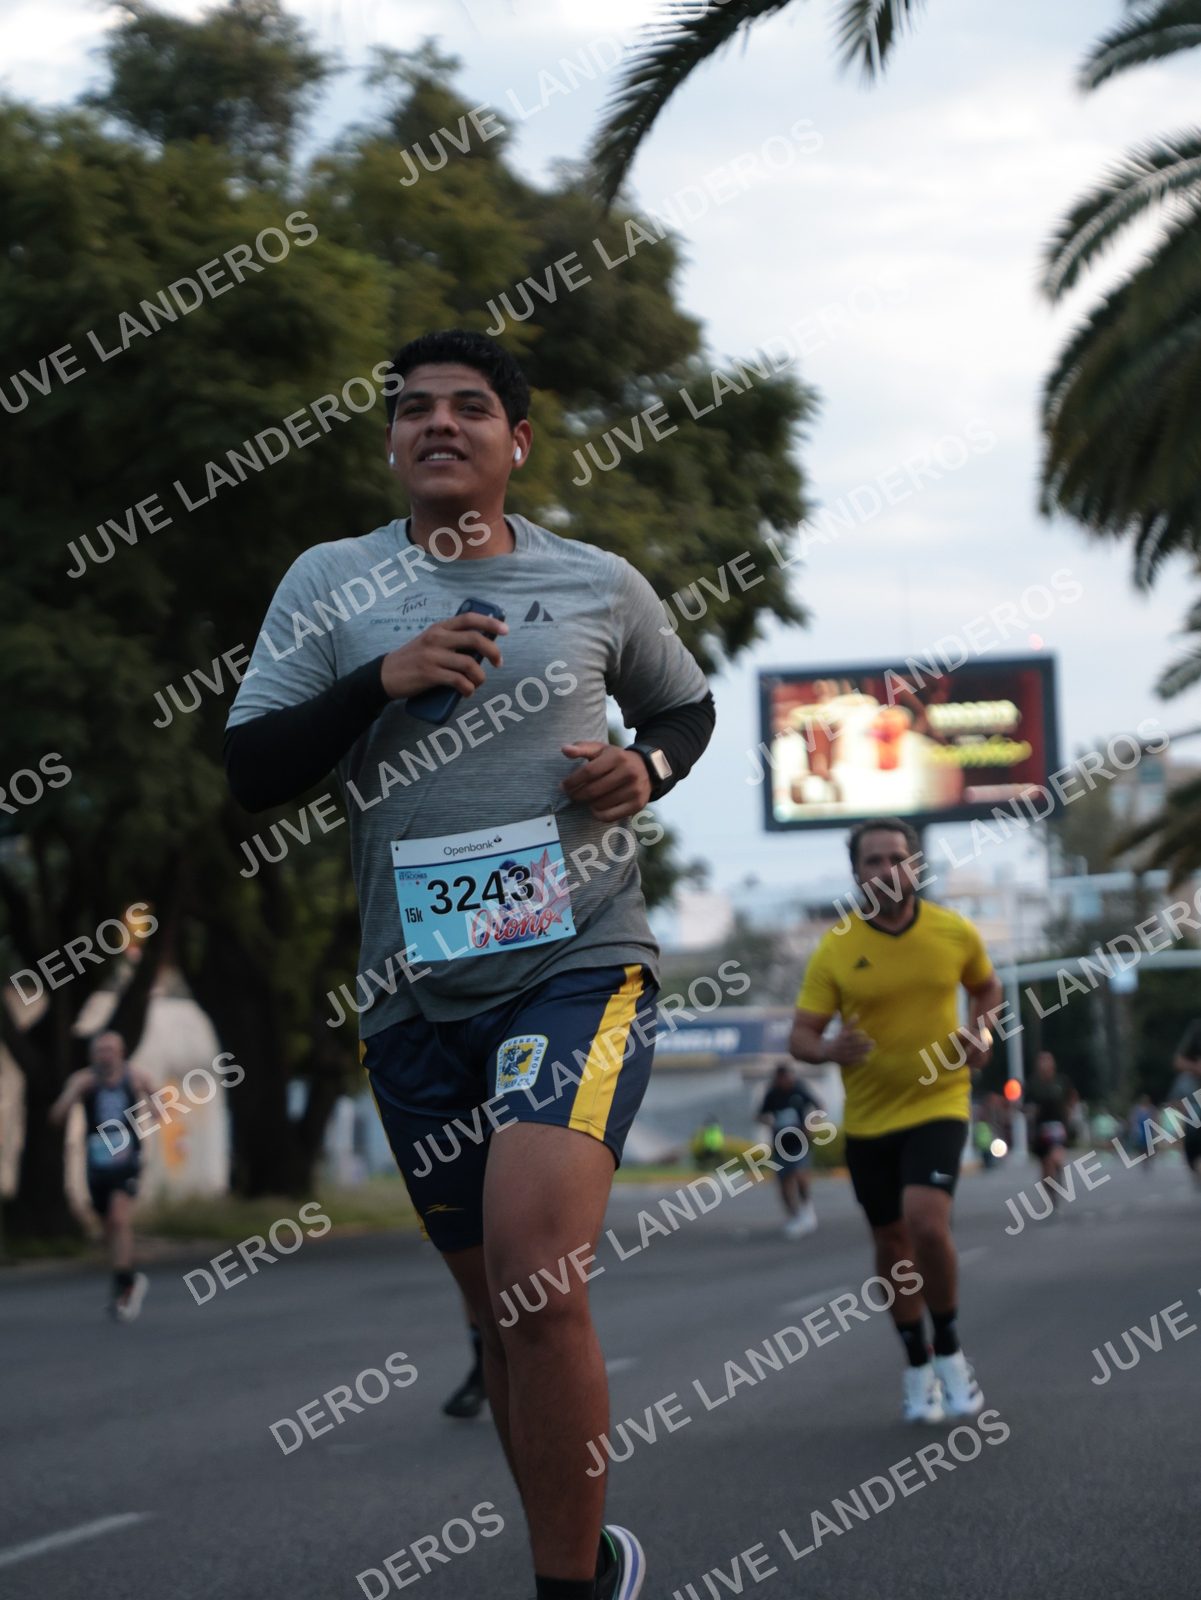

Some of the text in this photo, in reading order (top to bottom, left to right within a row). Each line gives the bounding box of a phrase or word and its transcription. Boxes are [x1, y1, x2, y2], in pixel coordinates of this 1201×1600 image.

[444, 839, 494, 857] Openbank
[427, 865, 535, 915] 3243
[405, 907, 423, 923] 15k
